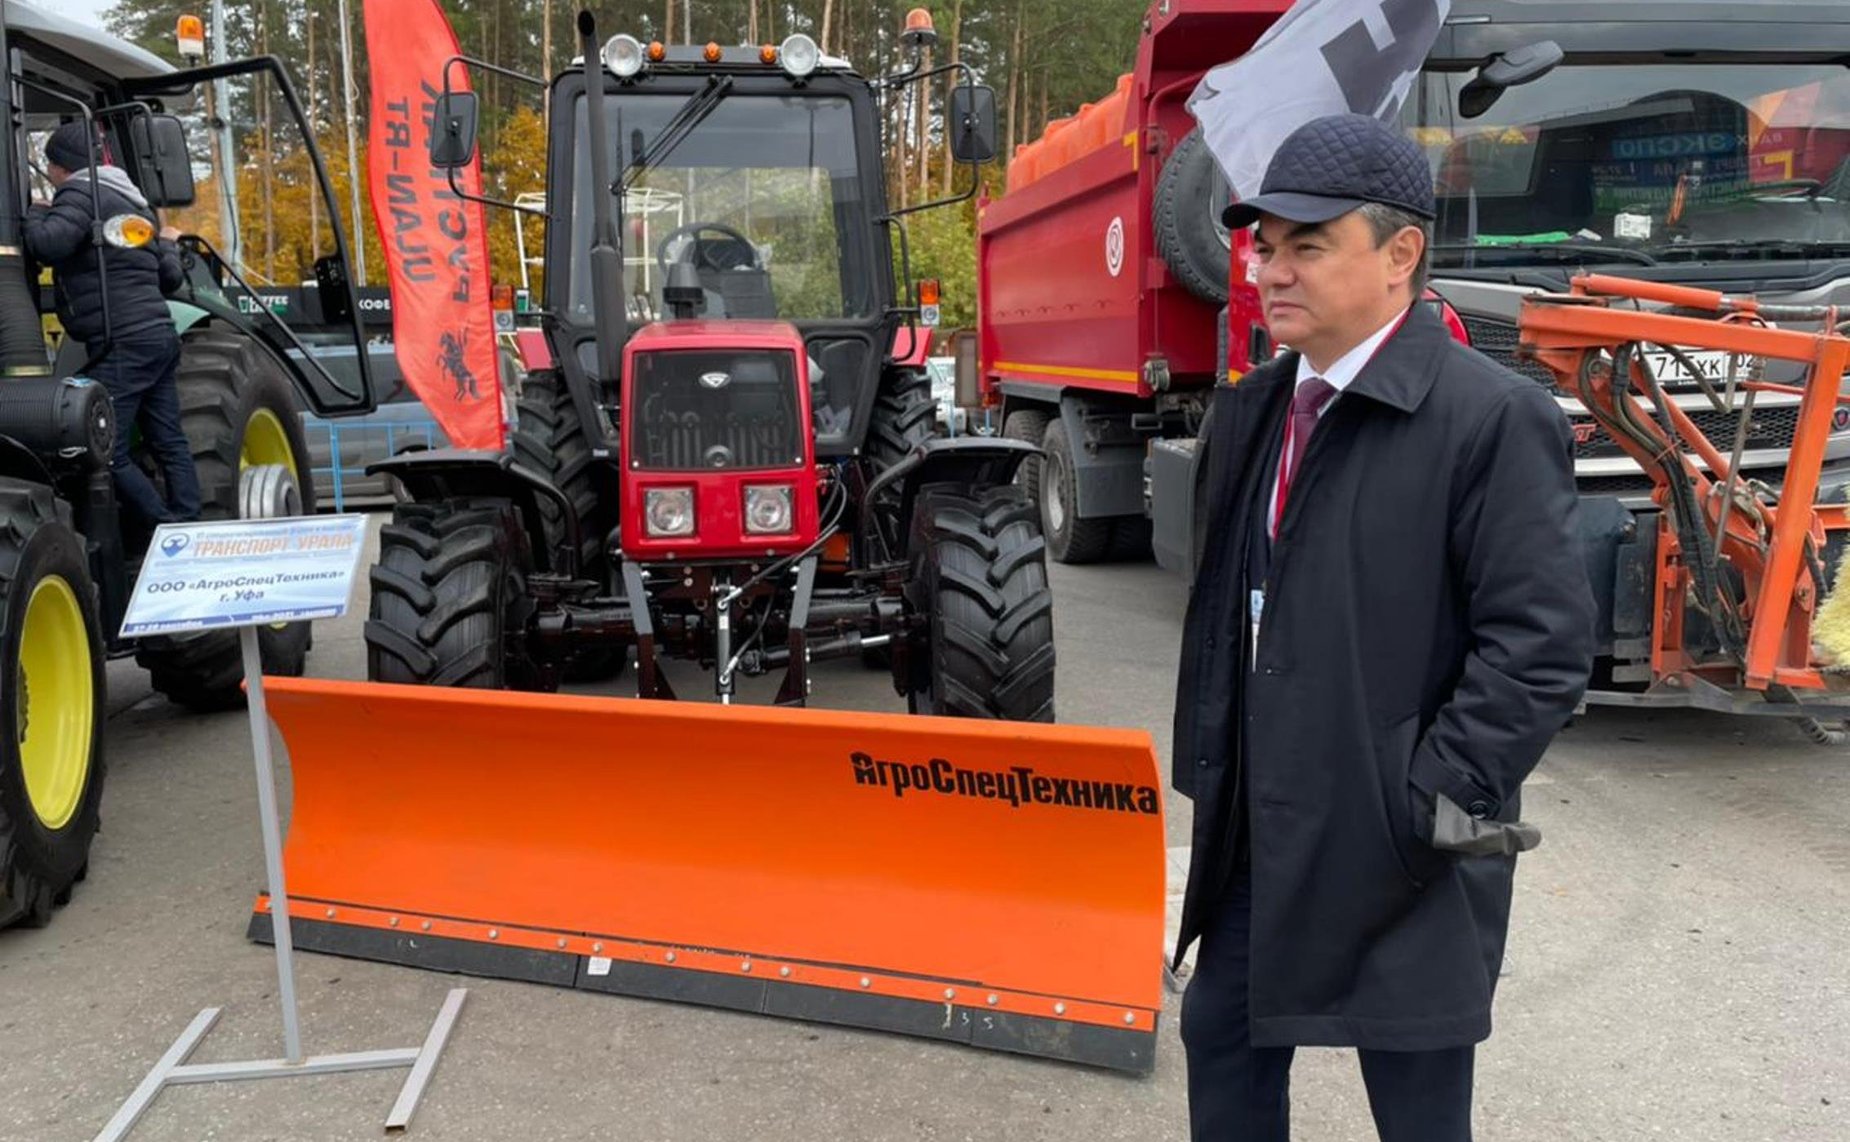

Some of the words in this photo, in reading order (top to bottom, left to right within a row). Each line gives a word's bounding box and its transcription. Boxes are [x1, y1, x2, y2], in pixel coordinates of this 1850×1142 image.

[193, 535, 290, 557] ТРАНСПОРТ
[297, 532, 353, 550] УРАЛА
[147, 580, 186, 593] ООО
[188, 570, 345, 591] «АгроСпецТехника»
[219, 592, 229, 602] г.
[234, 589, 265, 601] Уфа
[850, 752, 1159, 814] АгроСпецТехника
